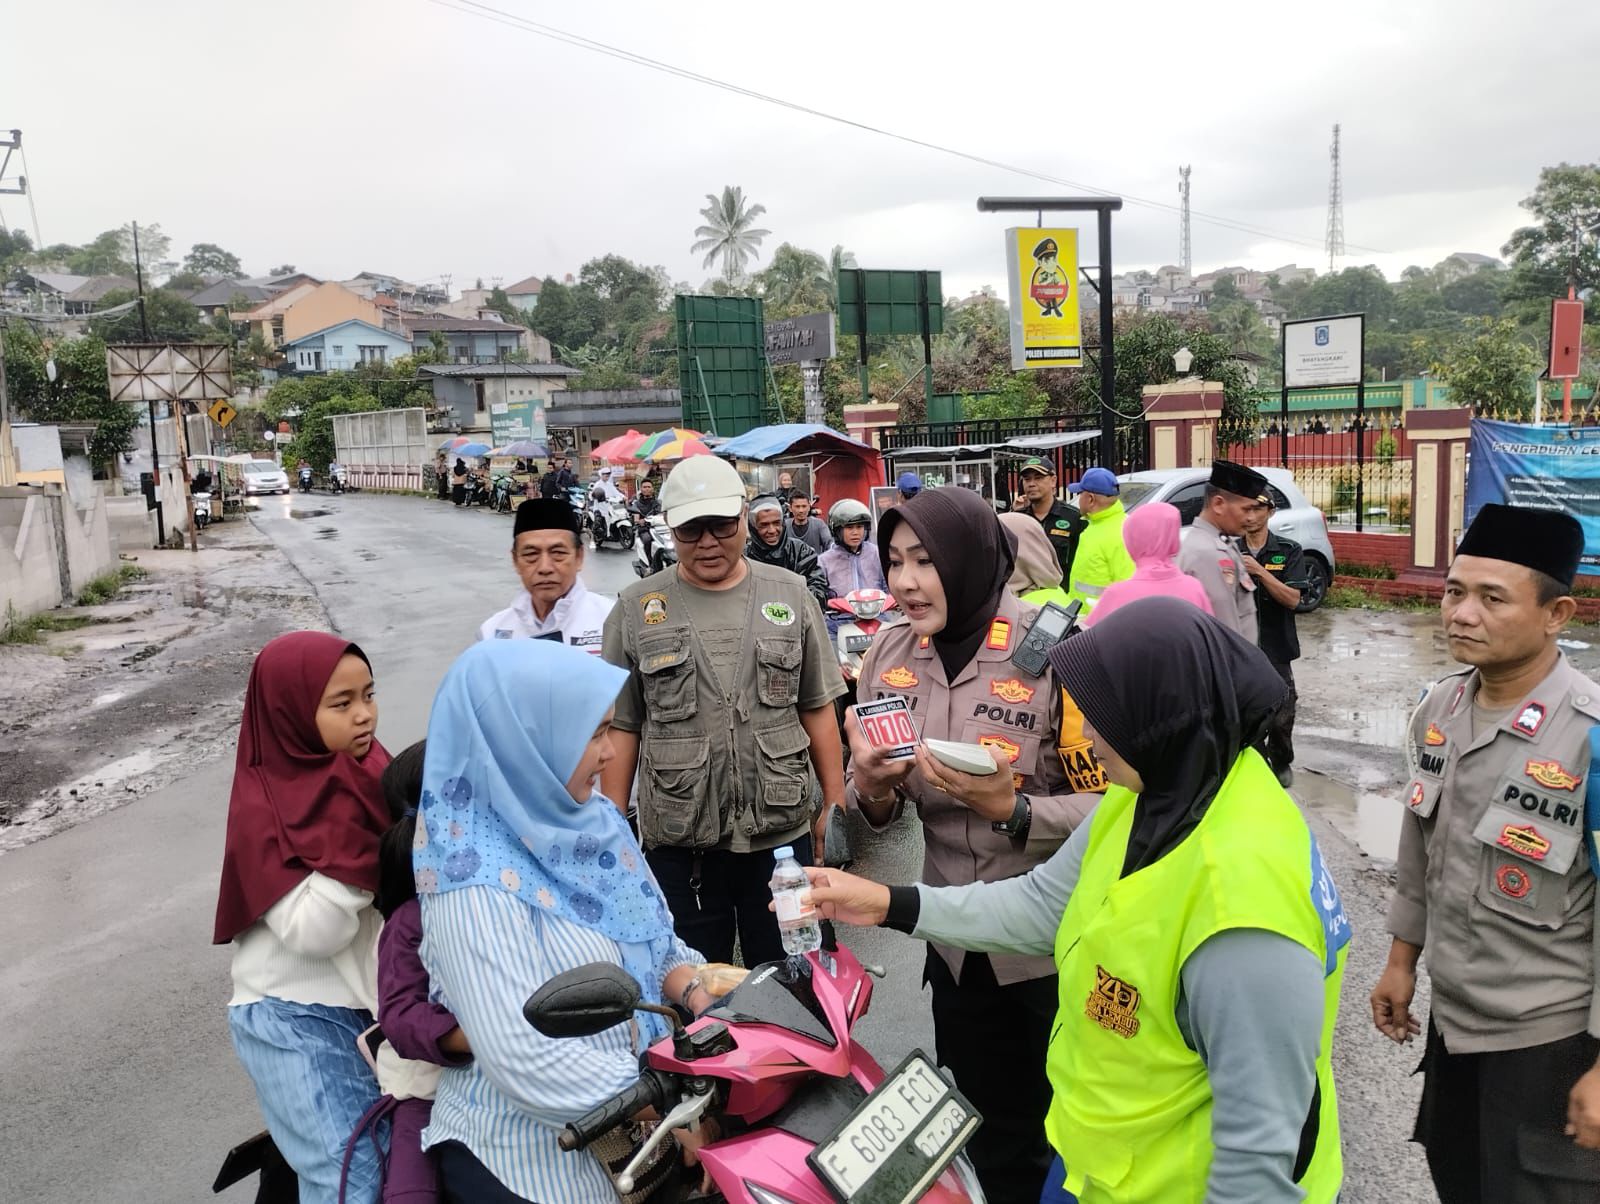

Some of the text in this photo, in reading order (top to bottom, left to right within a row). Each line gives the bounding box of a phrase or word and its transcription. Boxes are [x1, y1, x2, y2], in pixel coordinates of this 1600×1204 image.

[1492, 441, 1577, 455] PENGADUAN
[867, 715, 912, 744] 110
[973, 703, 1036, 730] POLRI
[1503, 784, 1579, 827] POLRI
[828, 1067, 940, 1190] F 6083 FCT
